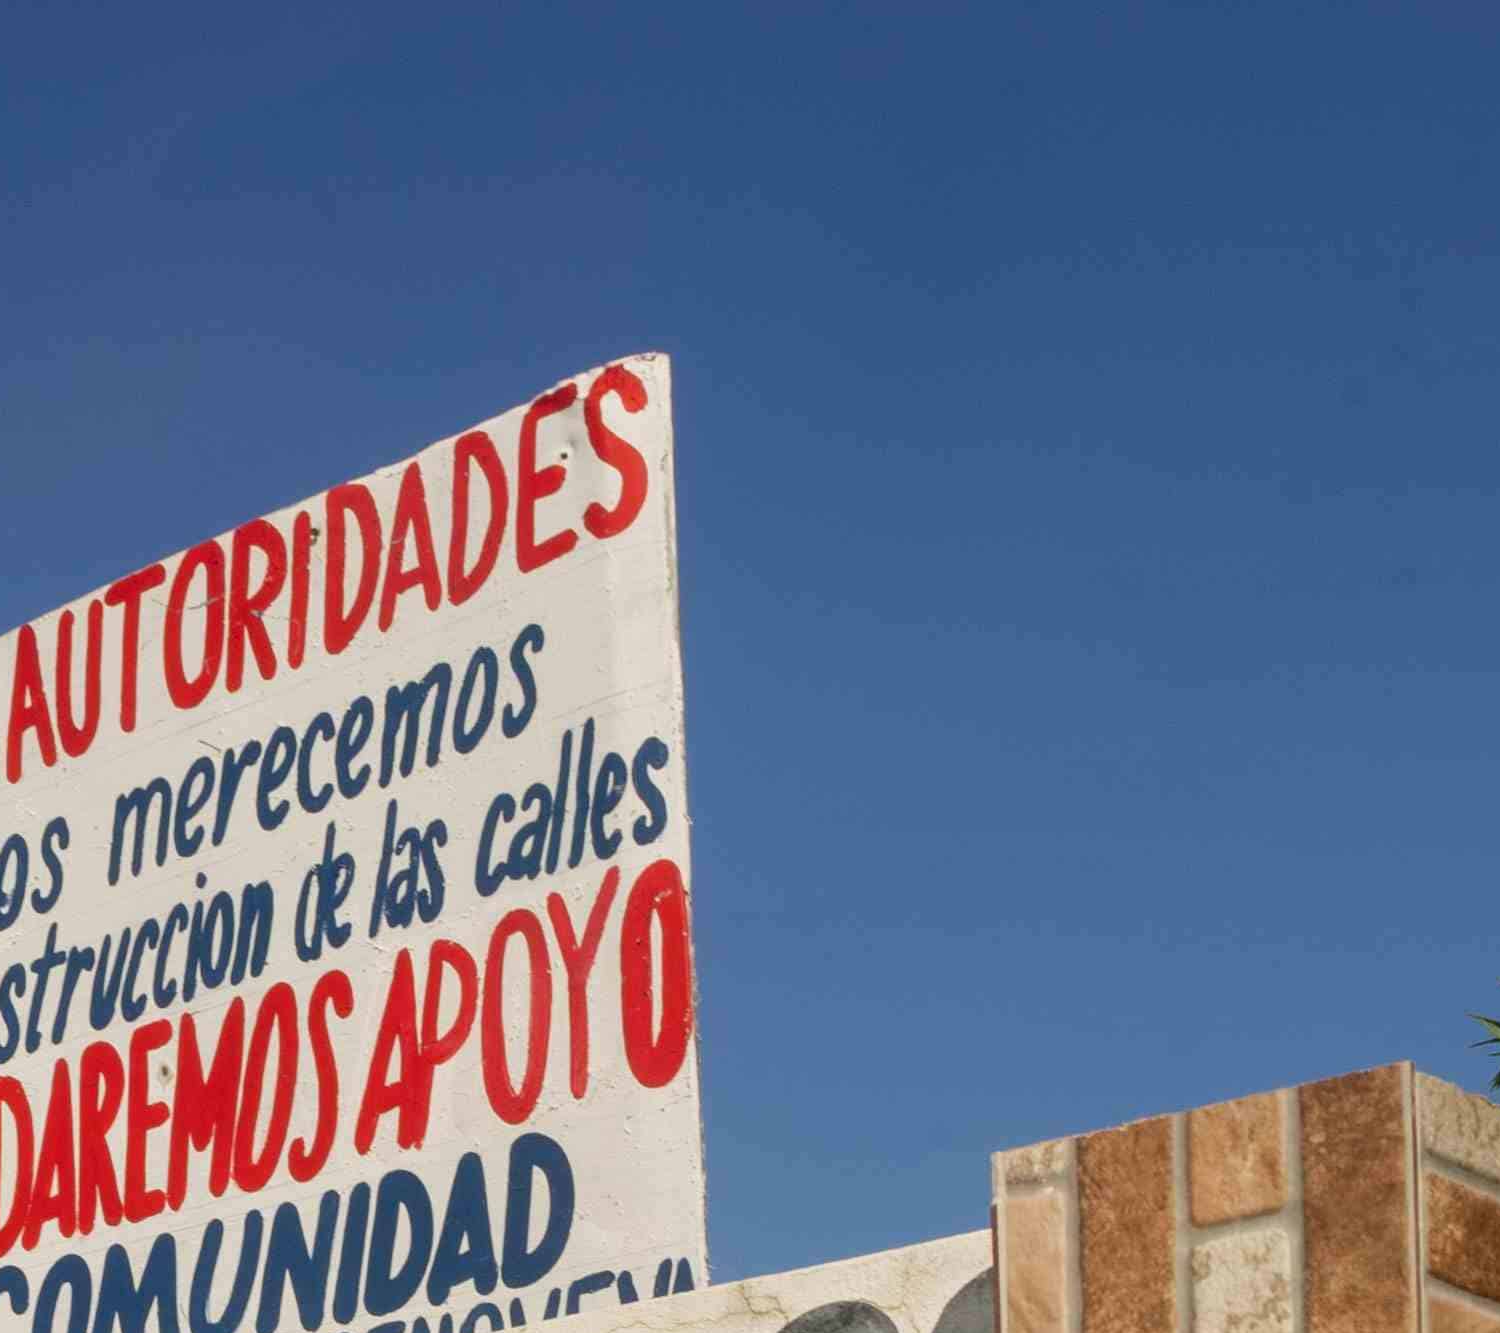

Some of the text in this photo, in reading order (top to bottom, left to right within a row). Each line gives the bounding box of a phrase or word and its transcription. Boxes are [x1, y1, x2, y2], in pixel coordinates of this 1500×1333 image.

[4, 362, 650, 785] AUTORIDADES
[108, 622, 546, 887] merecemos
[293, 820, 355, 963] de
[368, 800, 448, 938] las
[474, 717, 671, 897] calles
[353, 857, 696, 1156] APOYO
